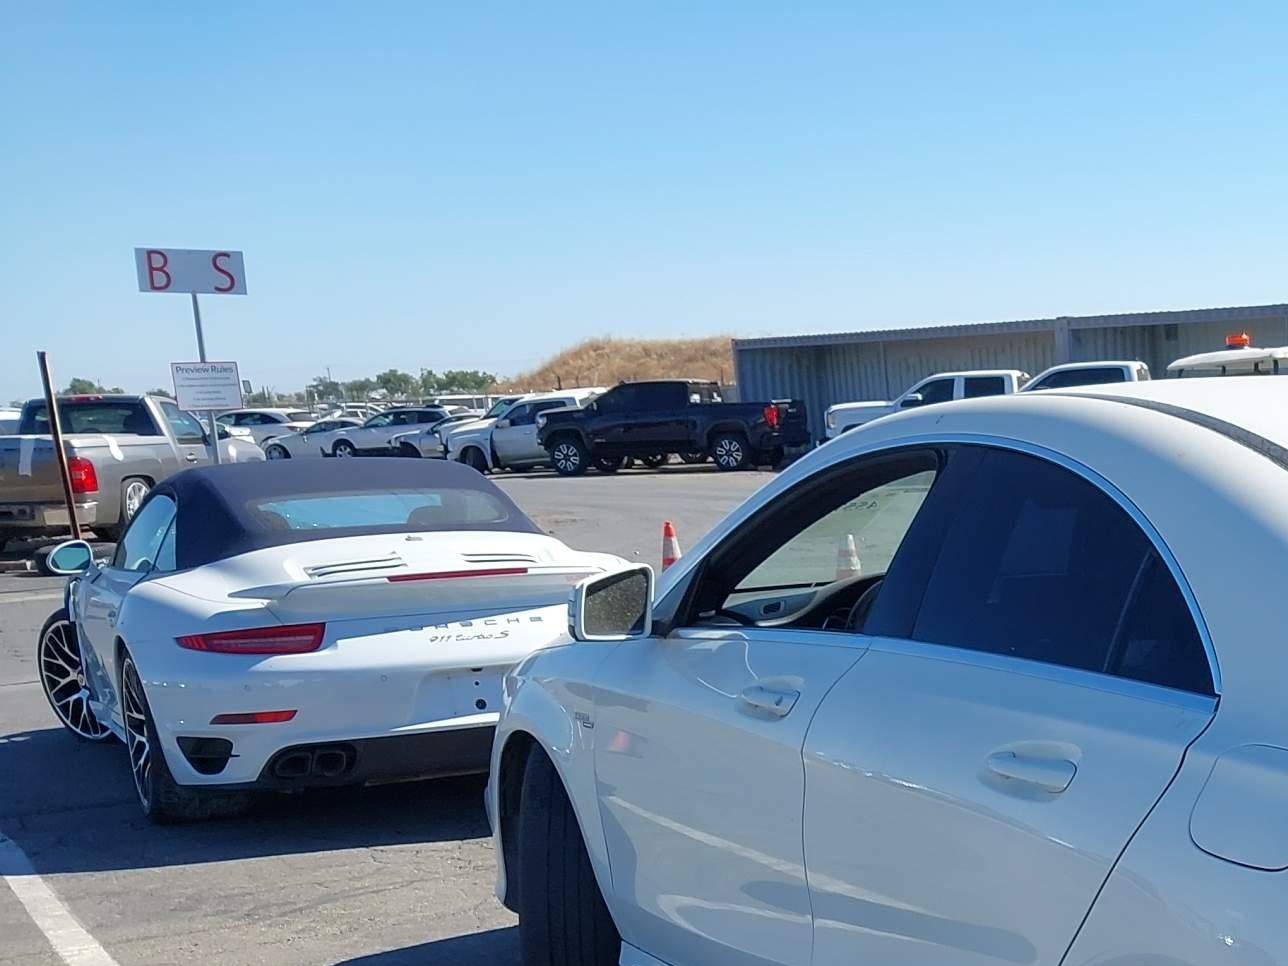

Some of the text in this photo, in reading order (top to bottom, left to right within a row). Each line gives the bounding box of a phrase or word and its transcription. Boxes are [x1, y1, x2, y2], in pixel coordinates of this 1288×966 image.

[146, 250, 236, 292] B S
[175, 366, 234, 375] Preview Rules
[386, 616, 544, 632] ORSCHE
